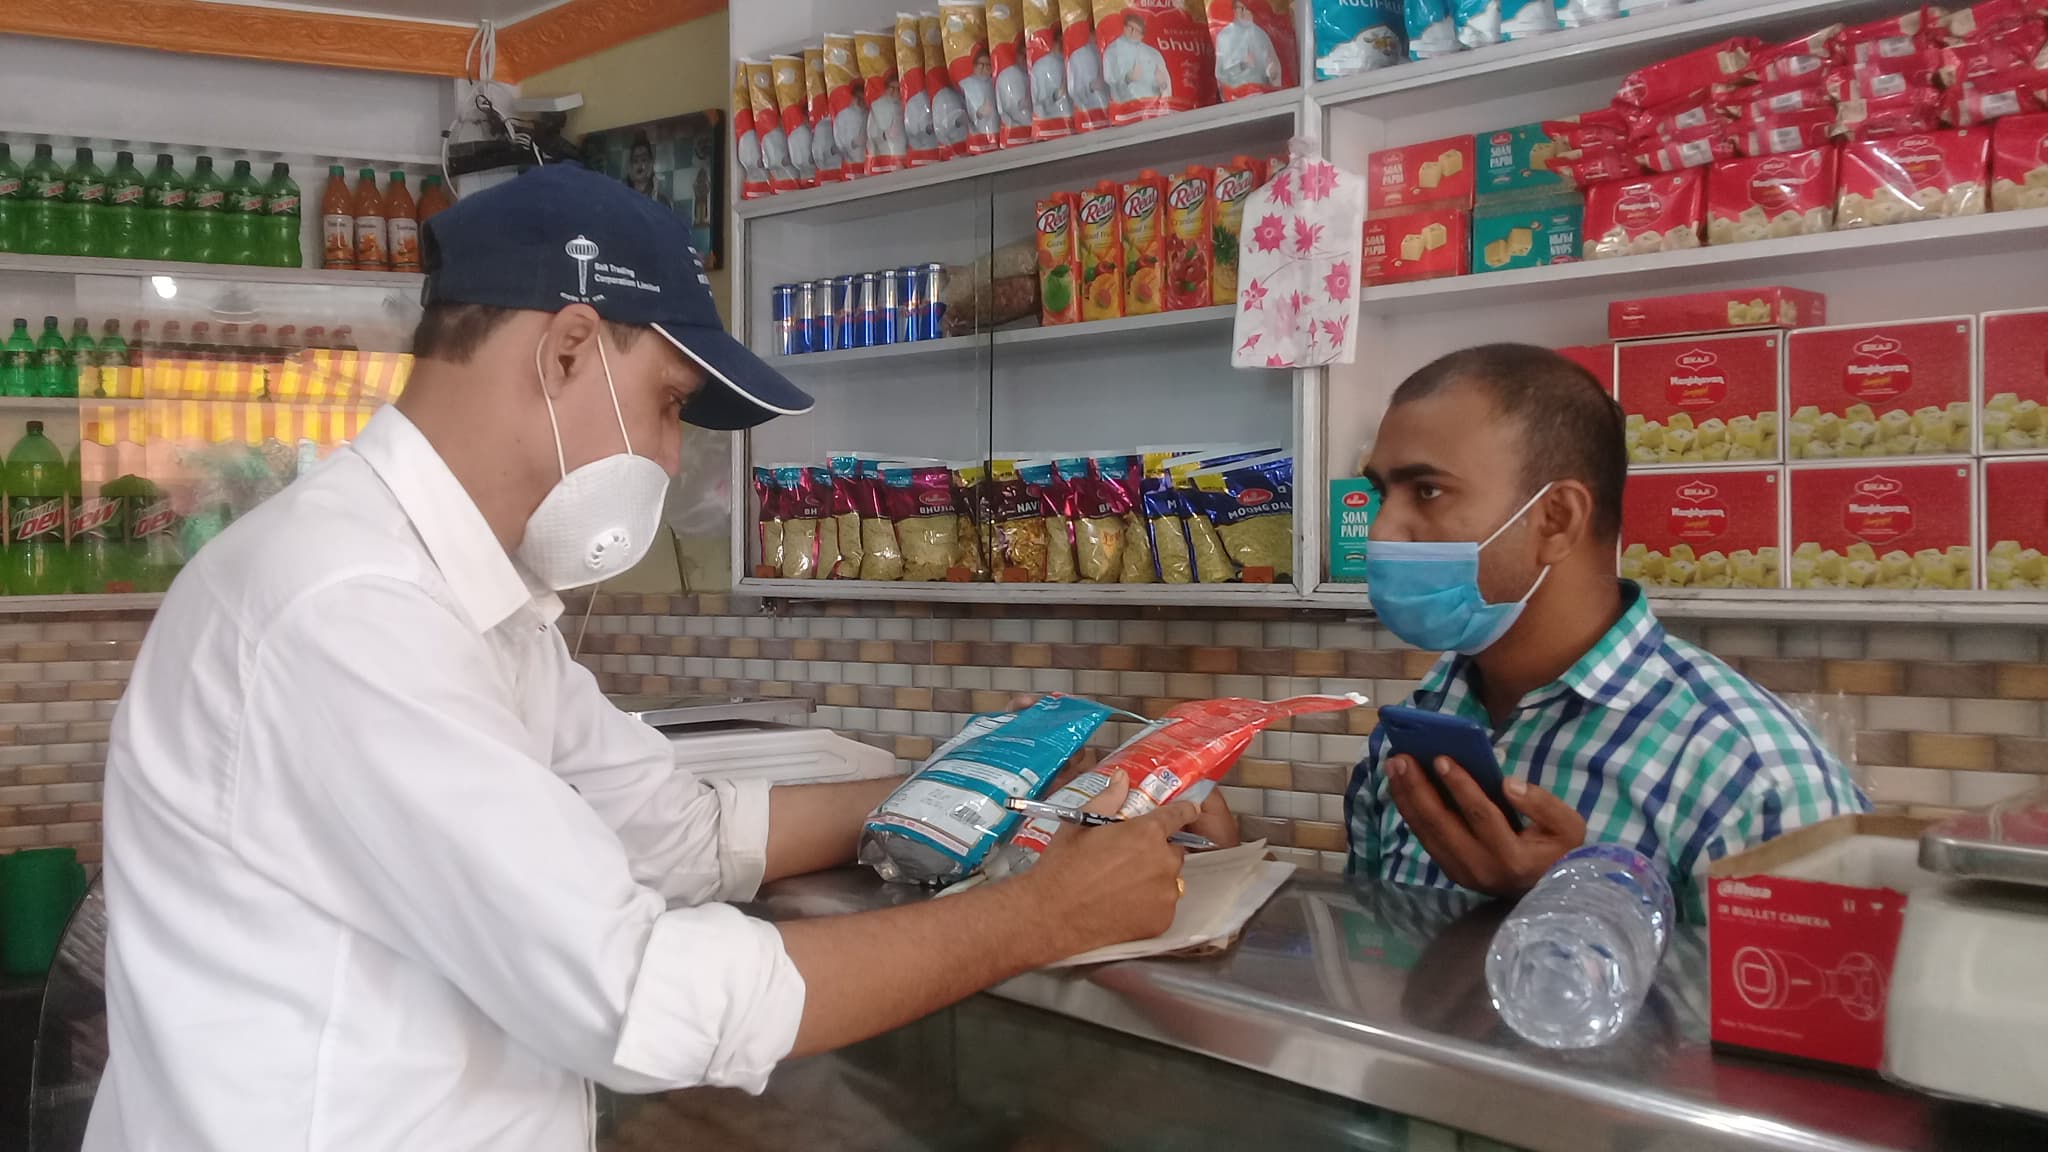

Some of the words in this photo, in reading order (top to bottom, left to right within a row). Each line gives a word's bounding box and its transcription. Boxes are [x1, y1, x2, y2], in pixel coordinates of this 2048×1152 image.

[1130, 189, 1157, 216] Real
[1175, 182, 1204, 207] Real
[1085, 199, 1113, 222] Real
[637, 280, 661, 293] Limited
[919, 505, 956, 516] BHUJIA
[1342, 512, 1368, 524] SOAN
[1341, 524, 1368, 538] PAPDI
[1731, 905, 1777, 921] BULLET
[1779, 911, 1831, 929] CAMERA
